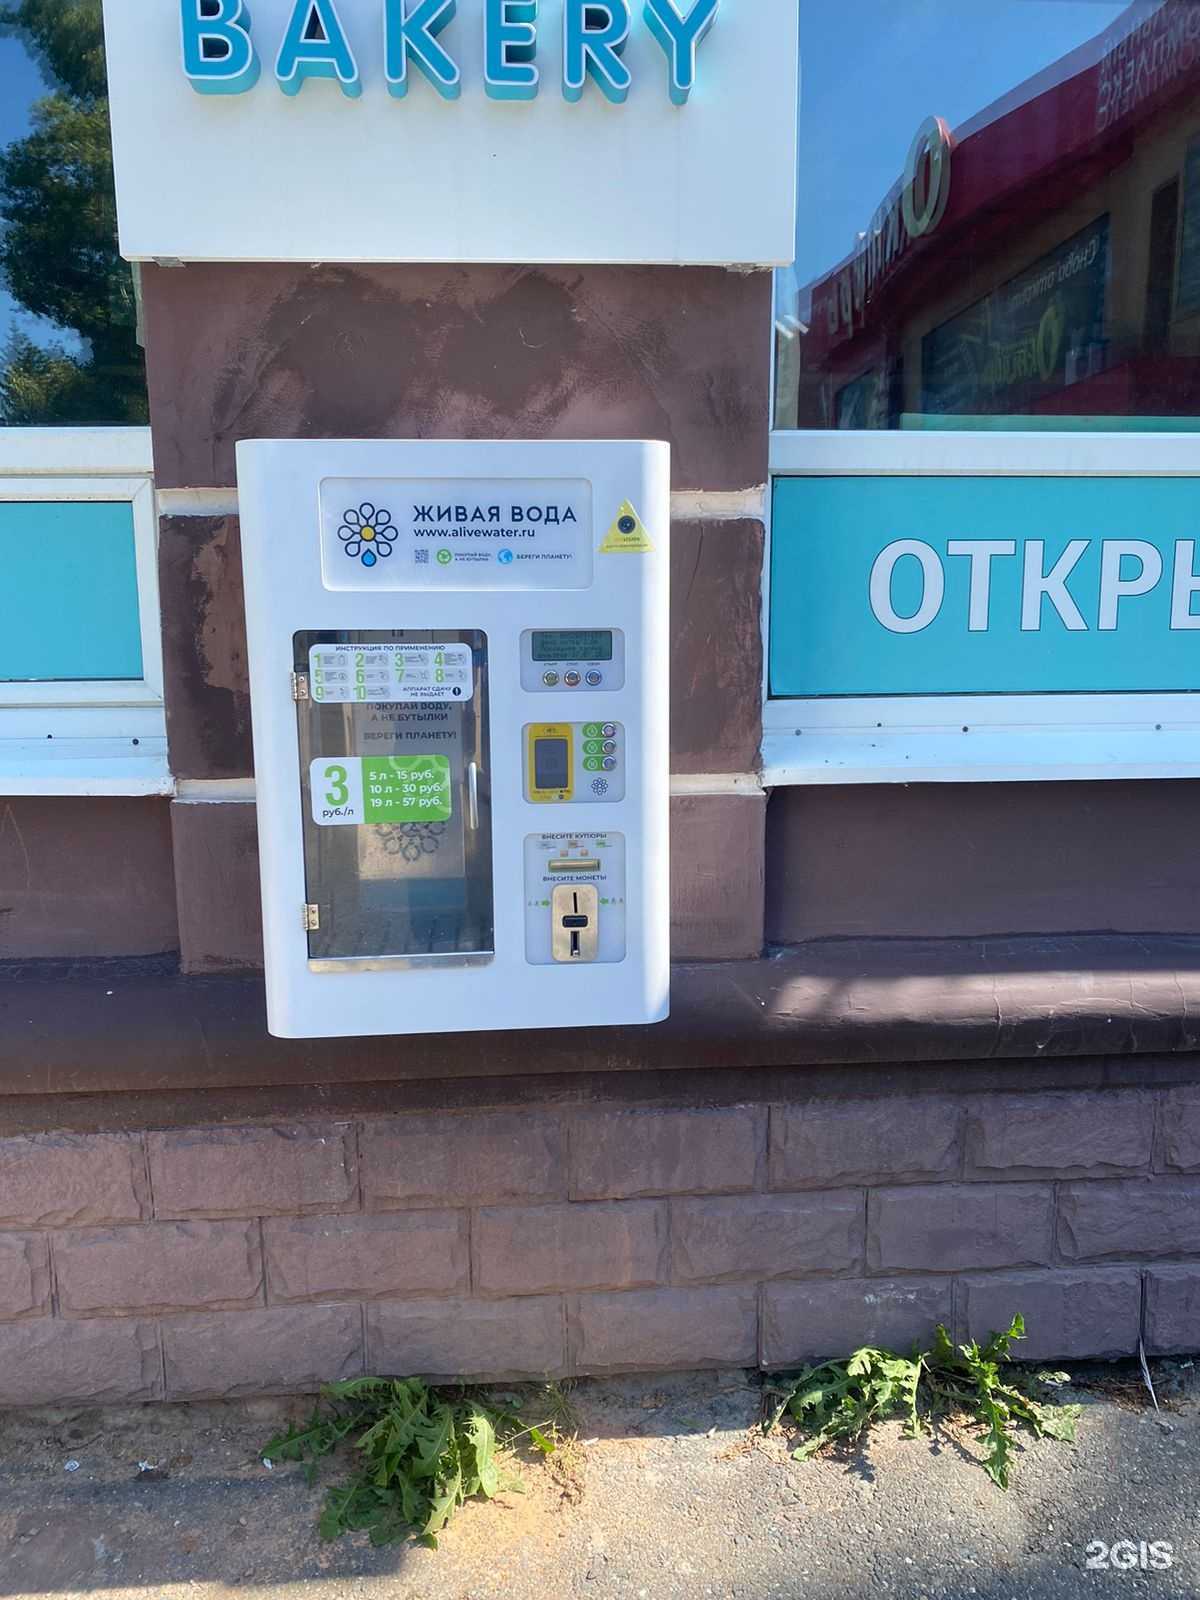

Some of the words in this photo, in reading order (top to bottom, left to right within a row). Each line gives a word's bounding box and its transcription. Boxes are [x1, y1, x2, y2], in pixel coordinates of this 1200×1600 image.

[180, 0, 720, 104] BAKERY
[412, 505, 500, 523] ЖИВАЯ
[510, 505, 577, 525] ВОДА
[413, 526, 535, 538] www.alivewater.ru
[355, 653, 365, 668] 2
[394, 652, 404, 668] 3
[434, 652, 444, 667] 4
[314, 669, 323, 685] 5
[356, 669, 365, 684] 6
[395, 668, 405, 684] 7
[435, 668, 444, 683] 8
[315, 686, 324, 701] 9
[353, 685, 367, 700] 10
[398, 713, 449, 721] БУТЫЛКИ
[363, 731, 402, 740] БЕРЕГИ
[405, 731, 457, 740] ПЛАНЕТУ!
[369, 771, 377, 780] 5
[397, 770, 408, 780] 15
[410, 769, 435, 781] руб.
[323, 764, 349, 806] 3
[369, 784, 382, 794] 10
[384, 785, 393, 794] л
[402, 784, 417, 793] 30
[419, 783, 443, 795] руб.
[370, 798, 383, 807] 19
[384, 799, 393, 807] л
[402, 797, 416, 806] 57
[419, 796, 443, 808] руб.
[322, 806, 355, 818] руб./л
